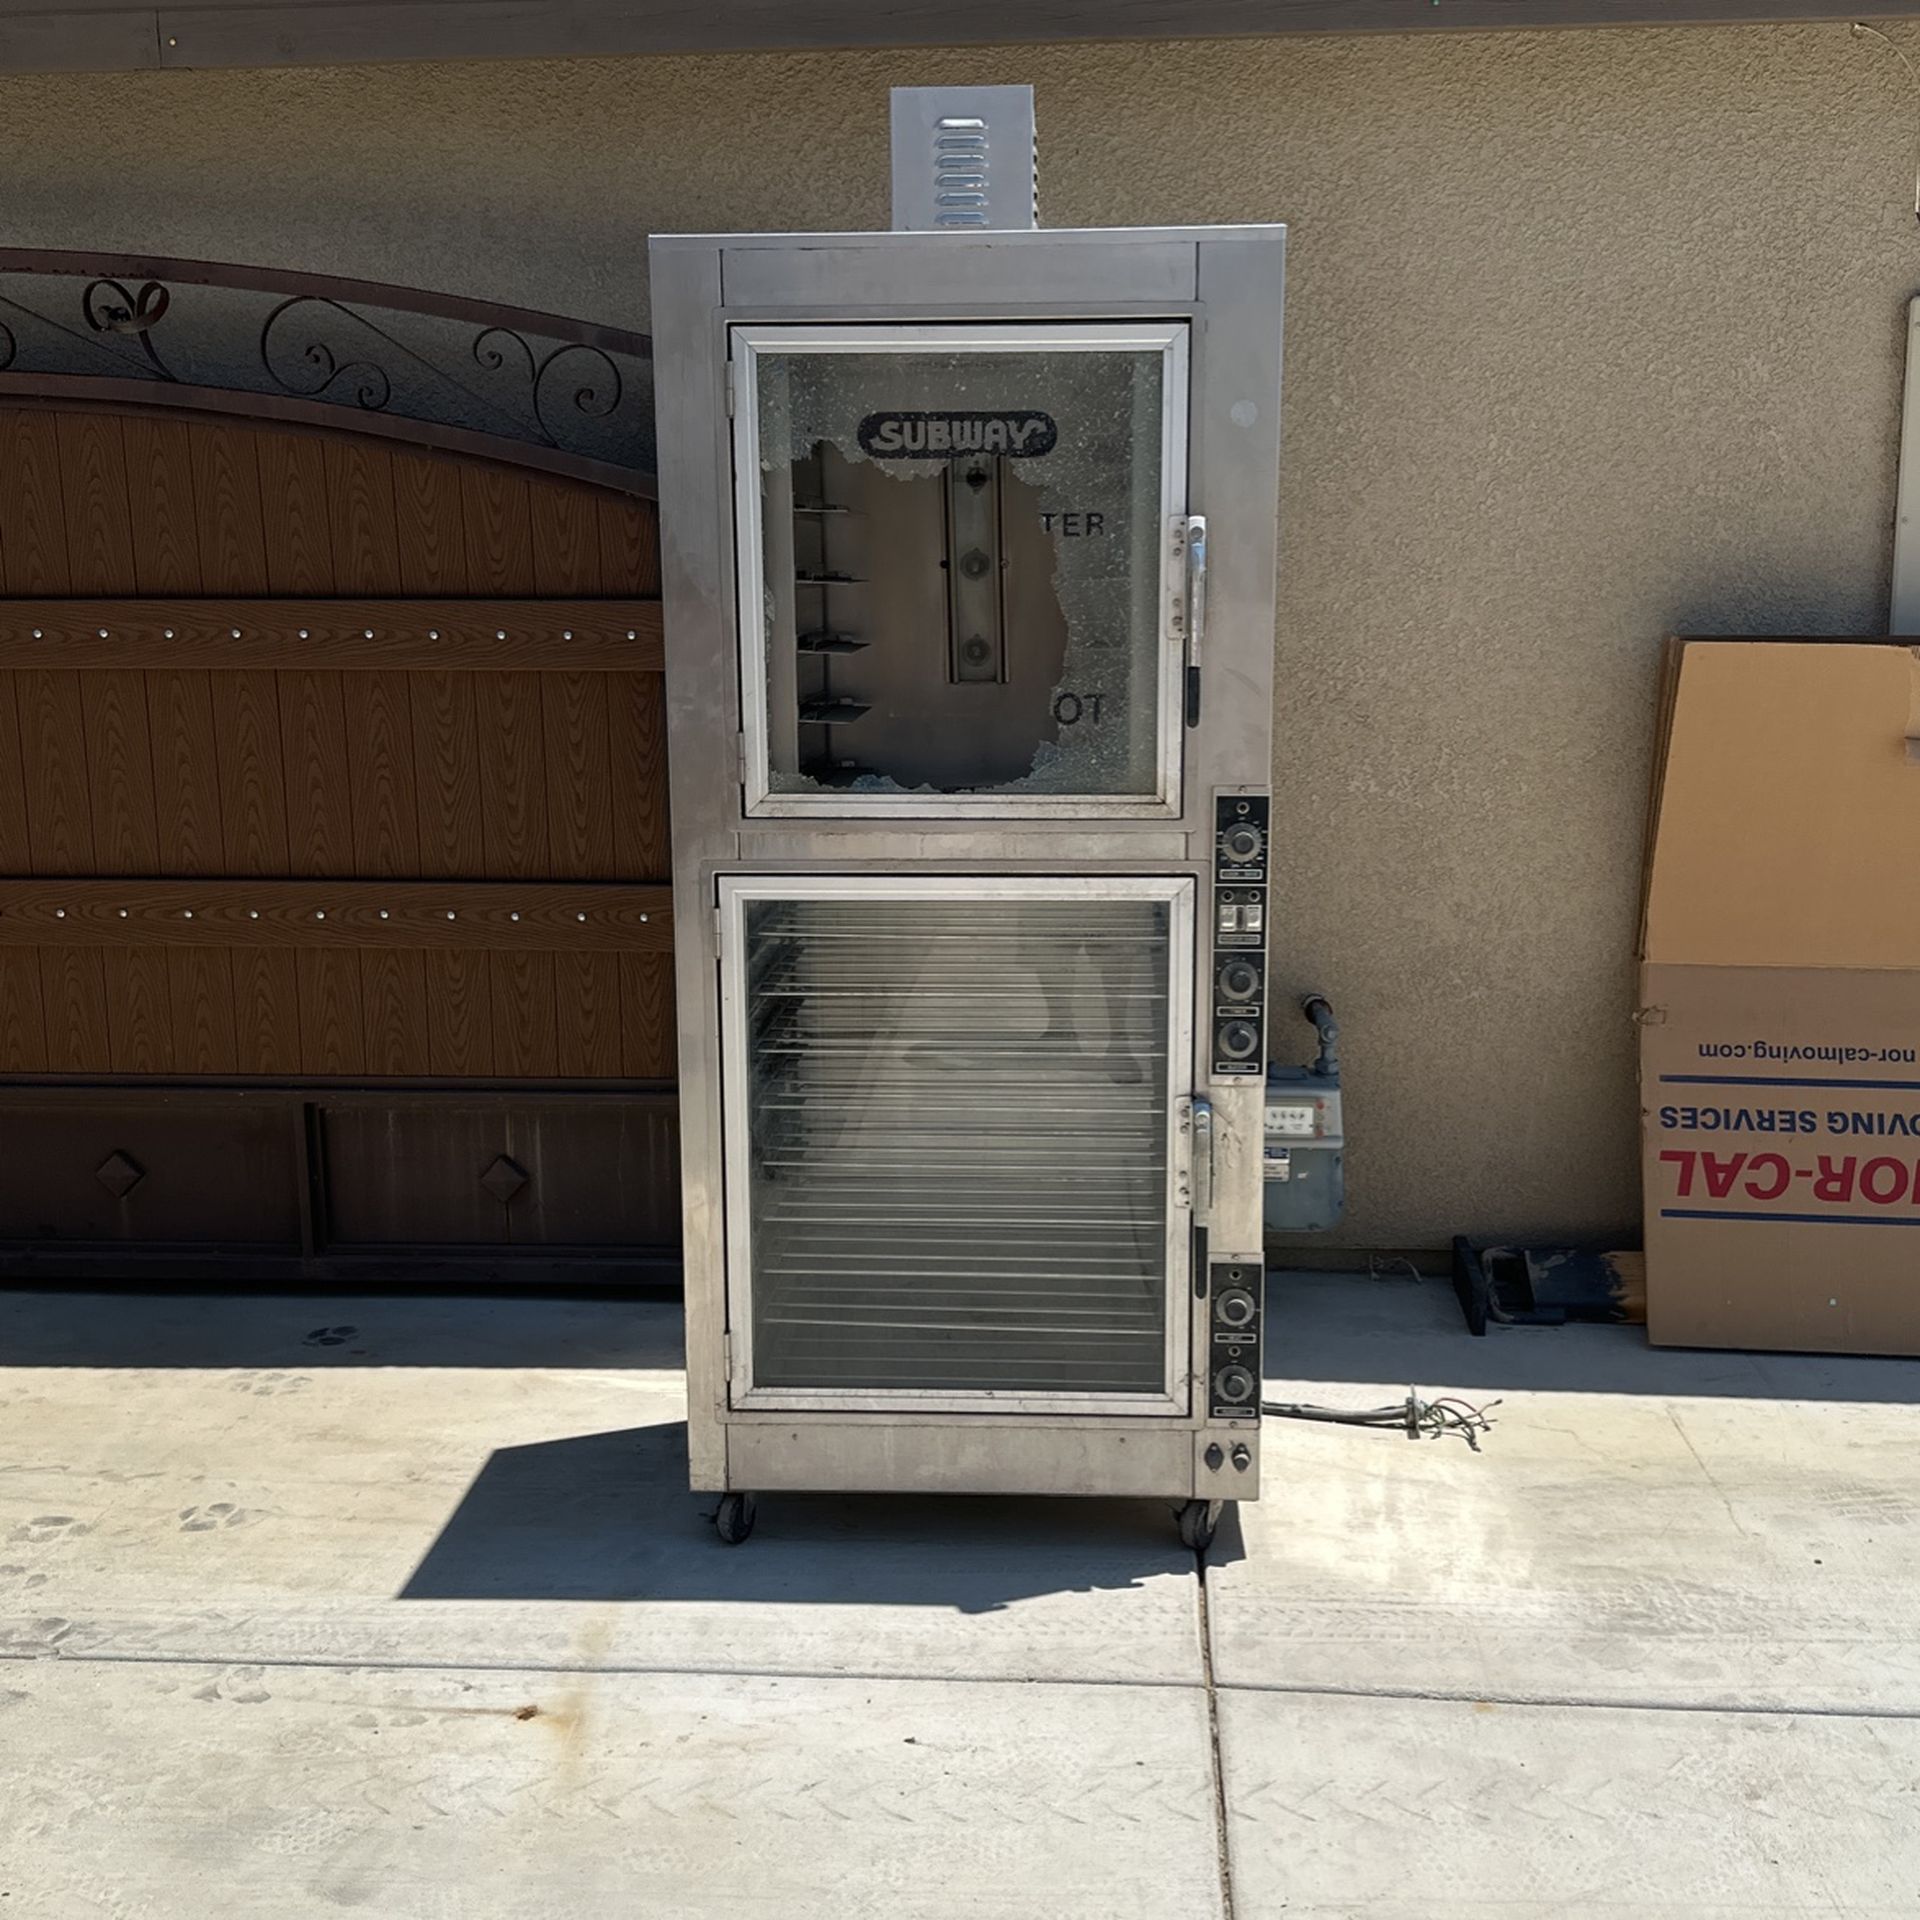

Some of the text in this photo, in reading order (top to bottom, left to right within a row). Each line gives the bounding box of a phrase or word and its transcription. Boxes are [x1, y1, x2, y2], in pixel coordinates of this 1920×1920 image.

[869, 419, 1047, 452] SUBWAY
[1698, 1041, 1916, 1064] nor-calmoving.com
[1659, 1105, 1817, 1134] SERVICES
[1659, 1150, 1920, 1206] OR-CAL
